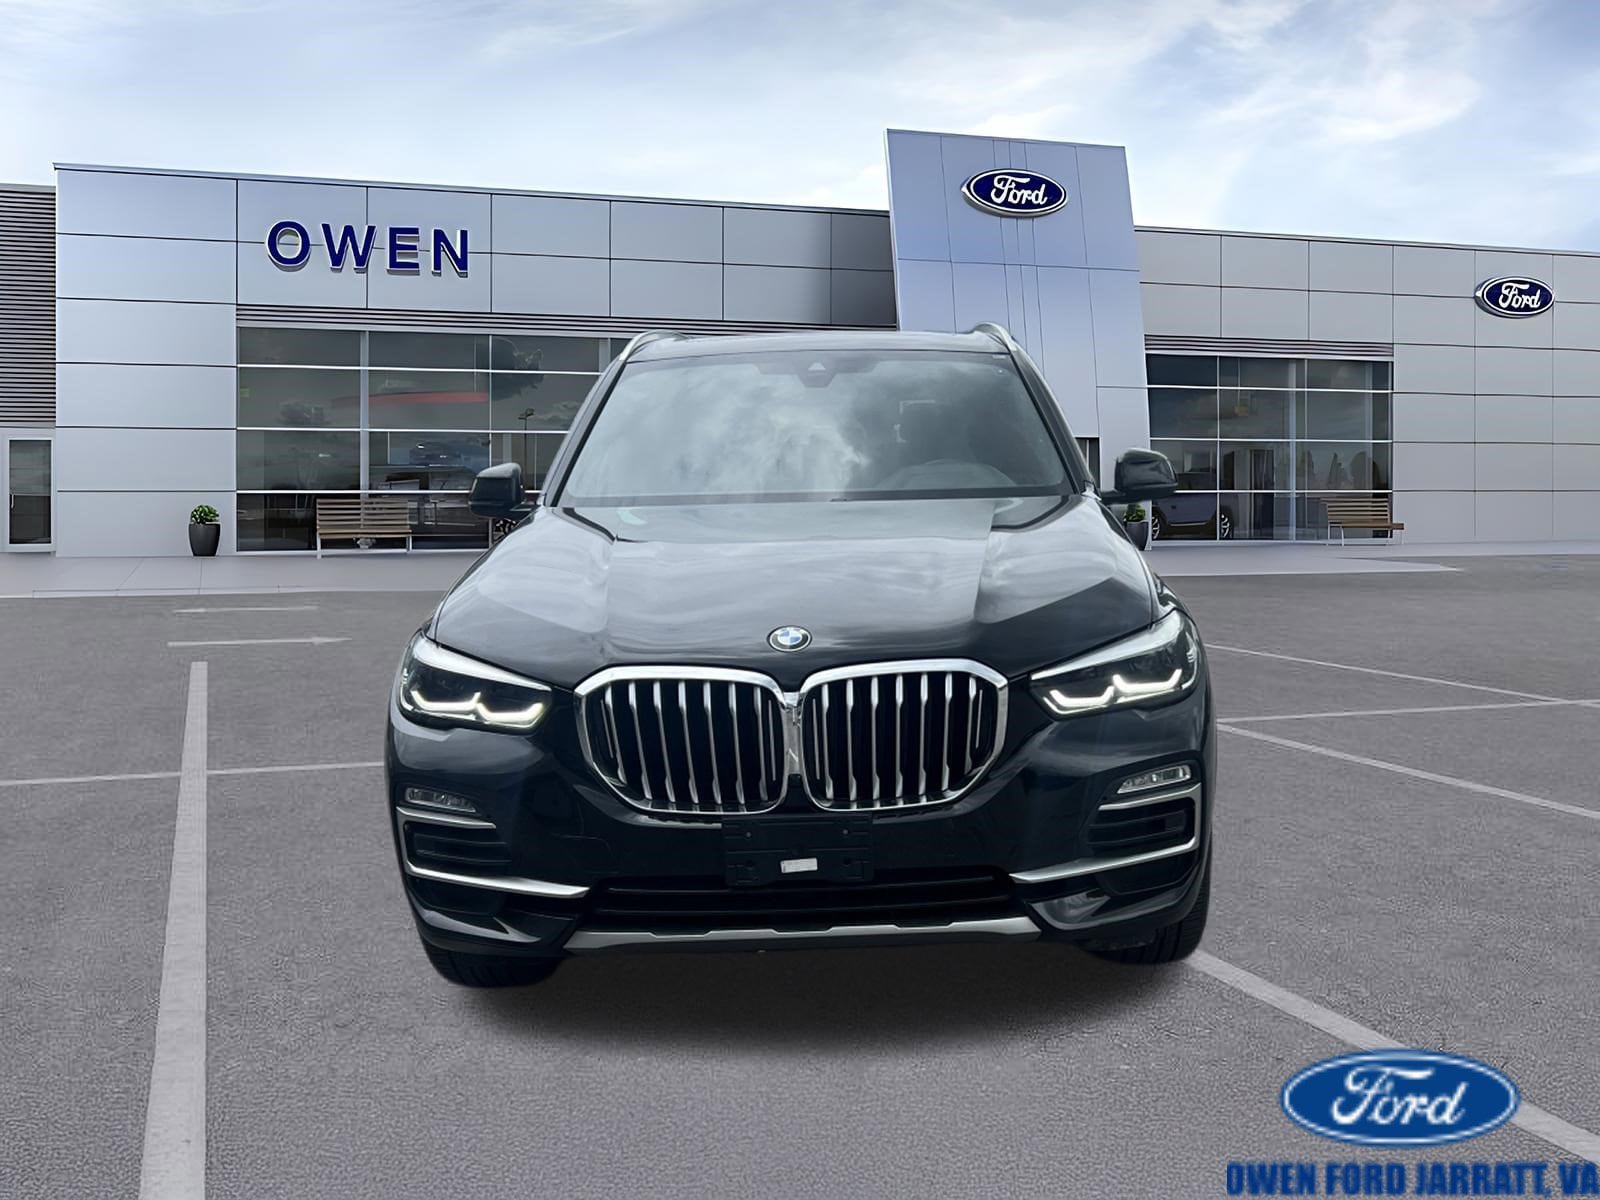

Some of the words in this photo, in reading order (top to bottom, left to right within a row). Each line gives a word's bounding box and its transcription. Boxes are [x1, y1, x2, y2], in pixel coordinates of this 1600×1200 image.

[990, 174, 1048, 205] Ford
[266, 219, 470, 278] OWEN
[1498, 282, 1541, 309] Ford
